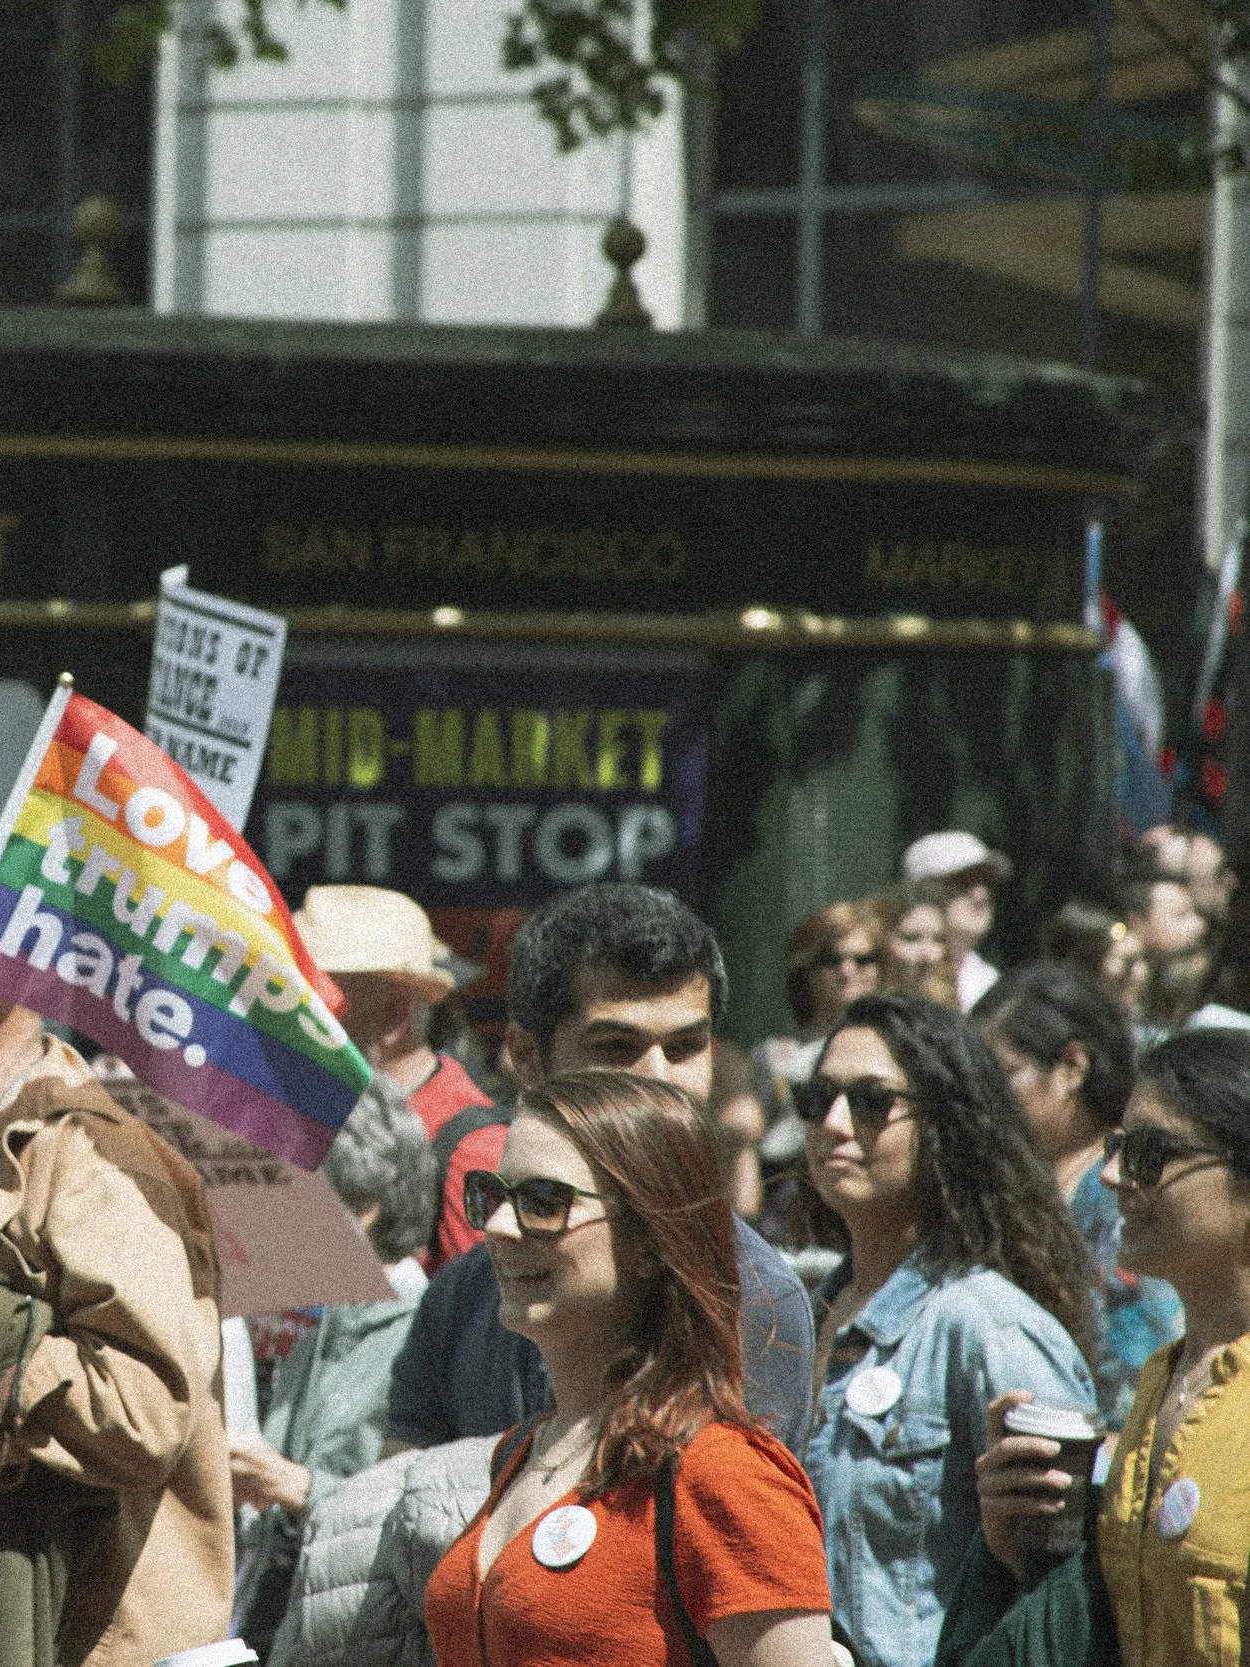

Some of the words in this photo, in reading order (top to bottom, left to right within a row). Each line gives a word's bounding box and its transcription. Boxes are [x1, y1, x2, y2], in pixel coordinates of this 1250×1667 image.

[265, 524, 371, 572] SAN
[383, 526, 687, 580] FRANCISCO
[270, 708, 668, 789] MID-MARKET
[73, 731, 272, 916] Love
[264, 803, 402, 880] PIT
[432, 804, 677, 882] STOP
[41, 815, 349, 1050] trumps
